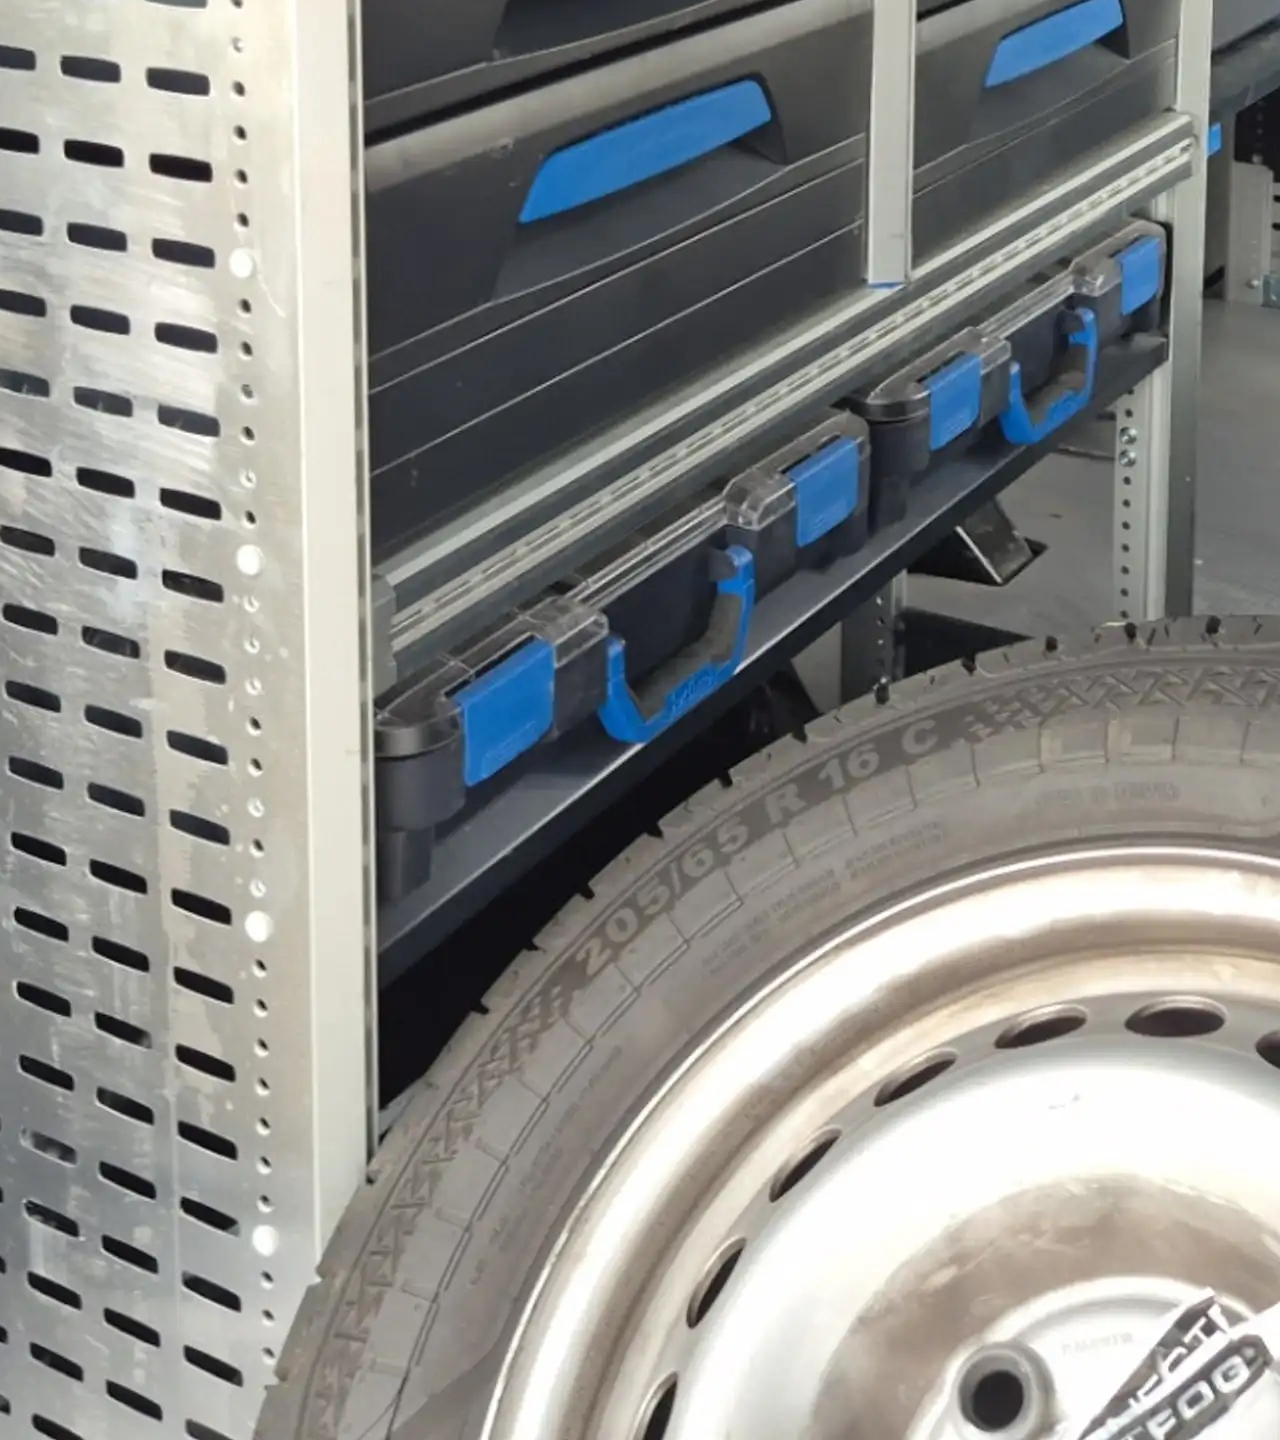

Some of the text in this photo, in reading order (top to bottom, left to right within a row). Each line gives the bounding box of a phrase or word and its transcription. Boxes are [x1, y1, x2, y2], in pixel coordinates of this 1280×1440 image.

[576, 718, 937, 976] 205/65 R 16 C
